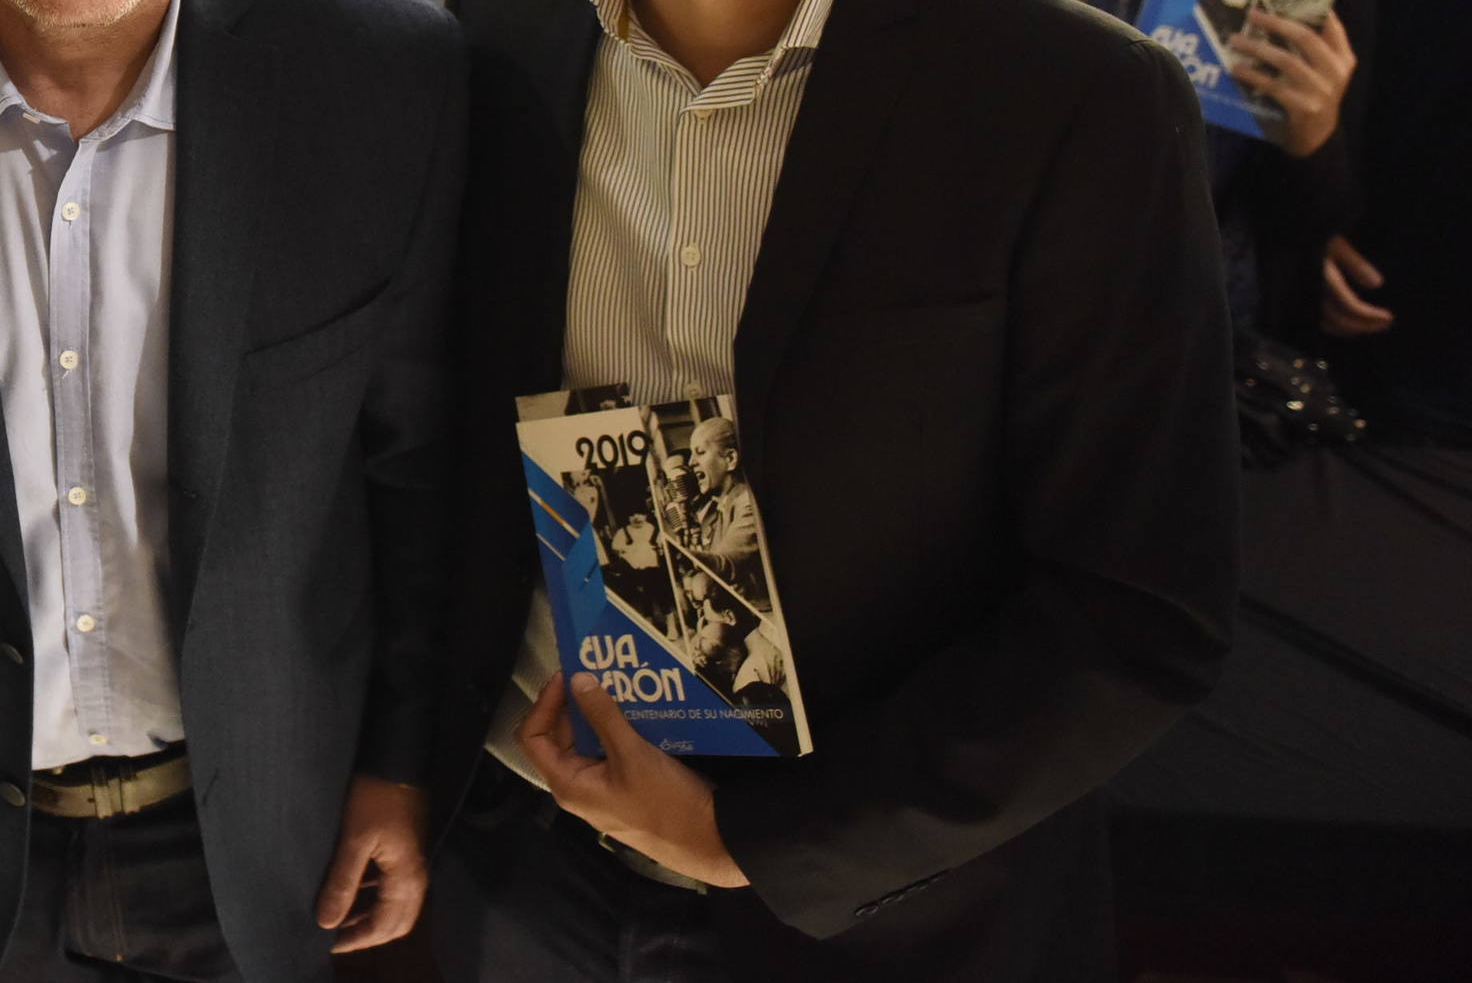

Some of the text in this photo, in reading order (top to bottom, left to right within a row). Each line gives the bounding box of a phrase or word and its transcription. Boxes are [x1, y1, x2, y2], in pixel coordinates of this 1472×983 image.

[576, 430, 650, 472] 2019
[579, 634, 639, 670] EVA
[590, 661, 686, 703] ERÓN
[688, 708, 702, 719] DE
[704, 708, 717, 719] SU
[719, 708, 784, 720] NACIMIENTO
